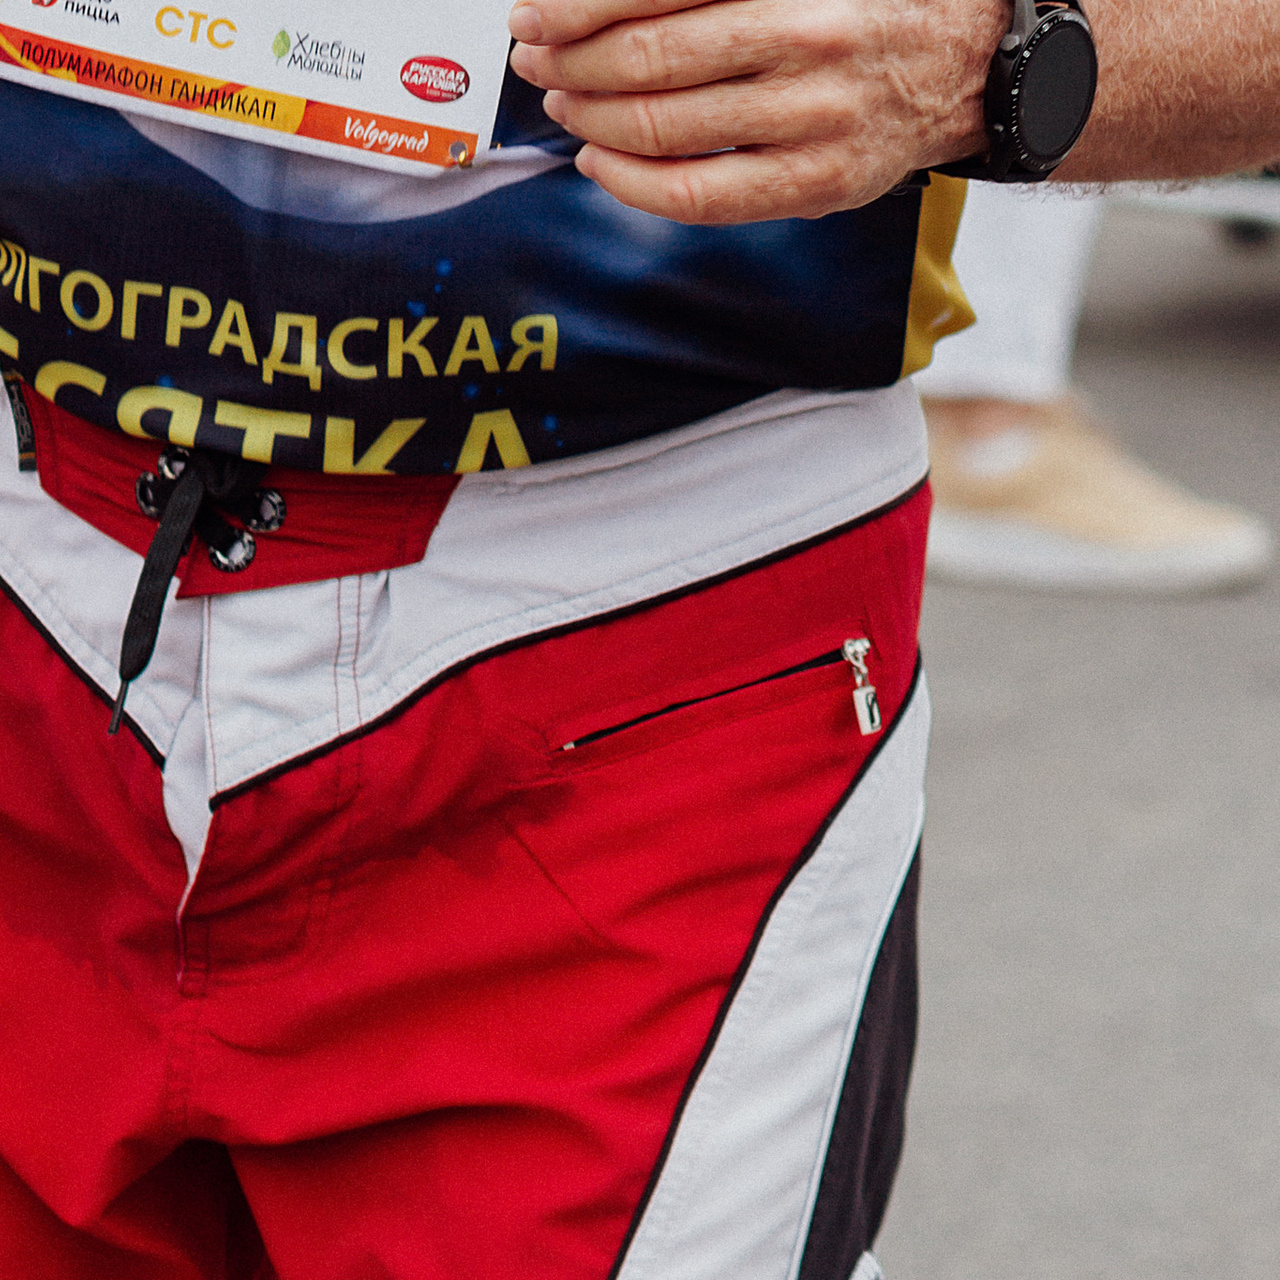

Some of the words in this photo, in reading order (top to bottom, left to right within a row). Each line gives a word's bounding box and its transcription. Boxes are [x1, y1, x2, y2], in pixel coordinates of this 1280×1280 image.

[64, 0, 120, 25] ПИЦЦА
[155, 6, 237, 49] СТС
[292, 31, 365, 66] Хлебцы
[20, 40, 162, 95] ПОЛУМАРАФОН
[170, 78, 276, 121] ГАНДИКАП
[287, 53, 363, 81] Молодцы
[344, 116, 429, 153] Volgograd
